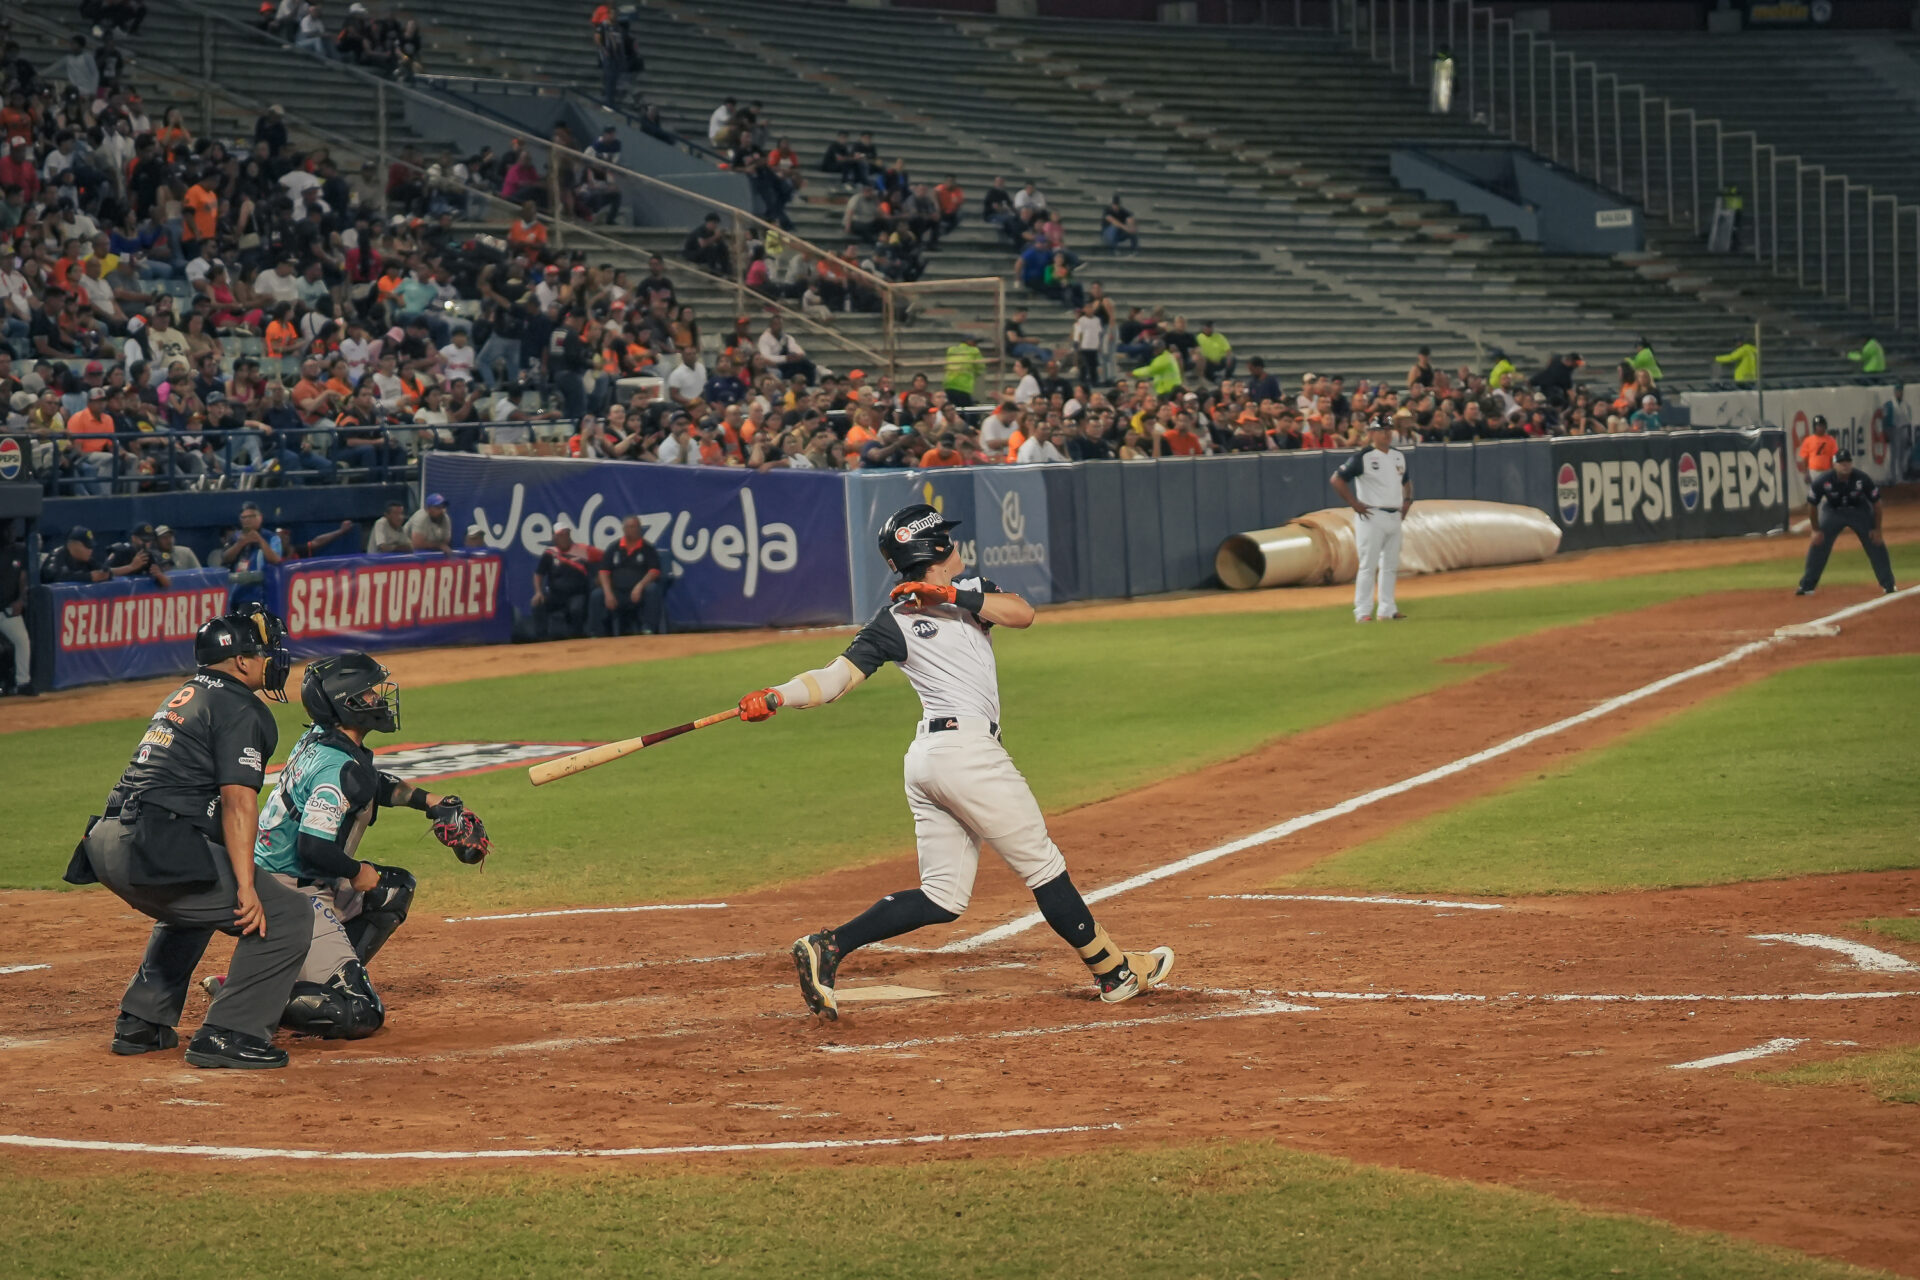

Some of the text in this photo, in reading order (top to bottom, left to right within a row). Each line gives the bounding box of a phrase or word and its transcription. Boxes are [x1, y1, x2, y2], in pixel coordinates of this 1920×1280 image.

[1582, 458, 1673, 525] PEPSI
[1700, 448, 1784, 511] PEPSI
[62, 592, 225, 646] SELLATUPARLEY
[289, 562, 499, 634] SELLATUPARLEY
[912, 621, 939, 637] PAN
